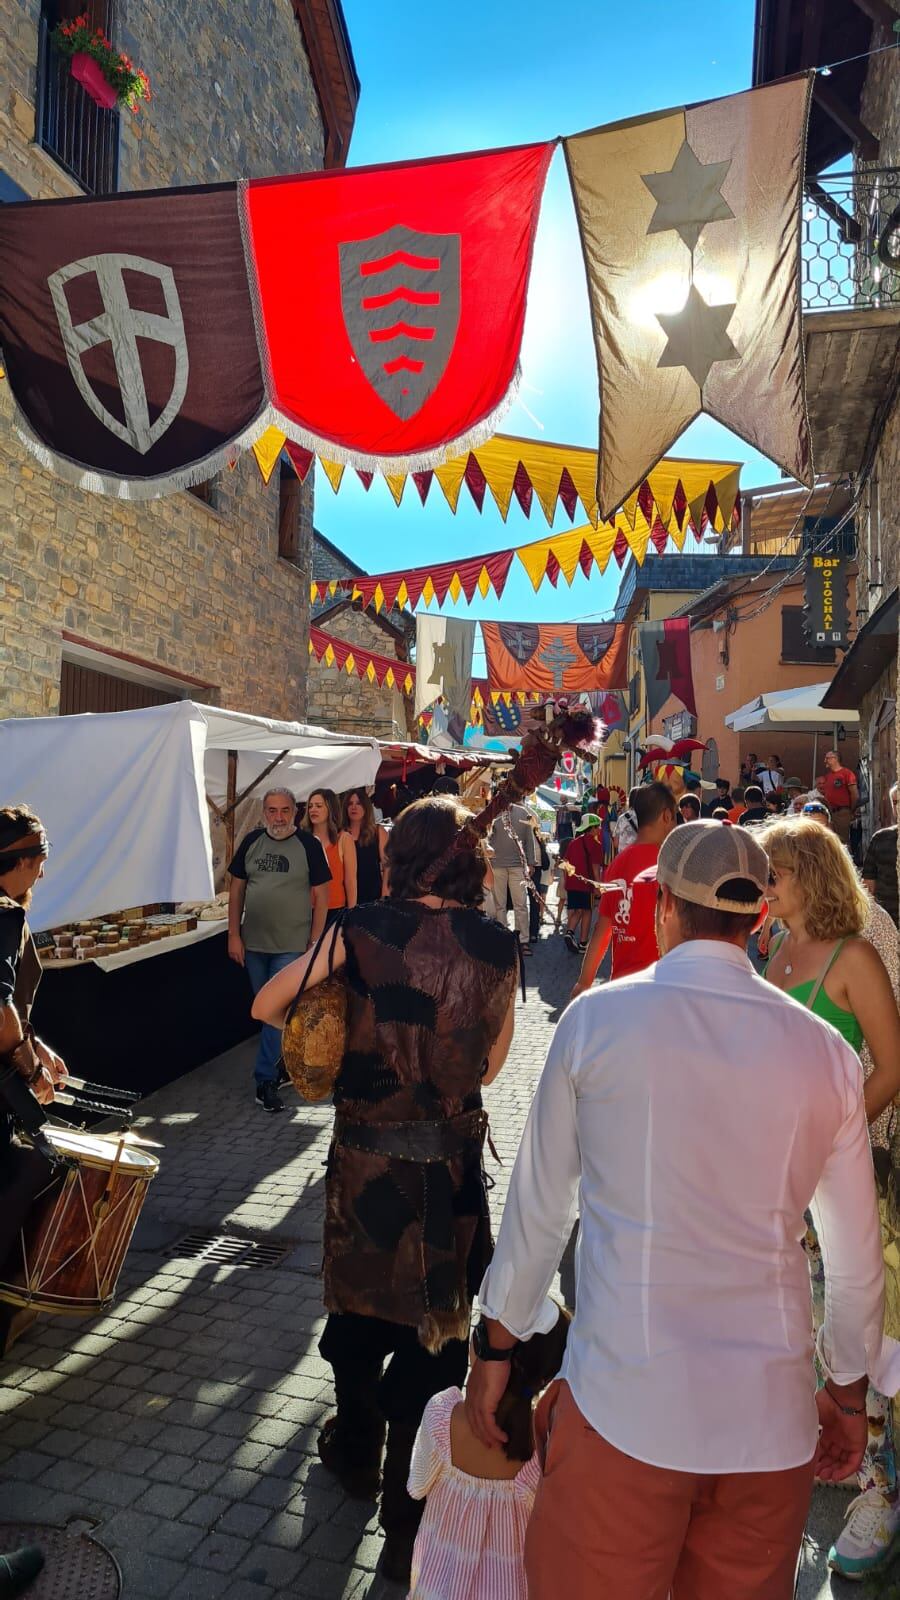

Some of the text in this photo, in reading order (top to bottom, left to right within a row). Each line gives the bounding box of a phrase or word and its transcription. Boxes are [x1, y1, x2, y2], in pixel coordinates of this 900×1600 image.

[813, 556, 840, 568] Bar
[265, 853, 281, 861] THE
[257, 864, 278, 872] FACE
